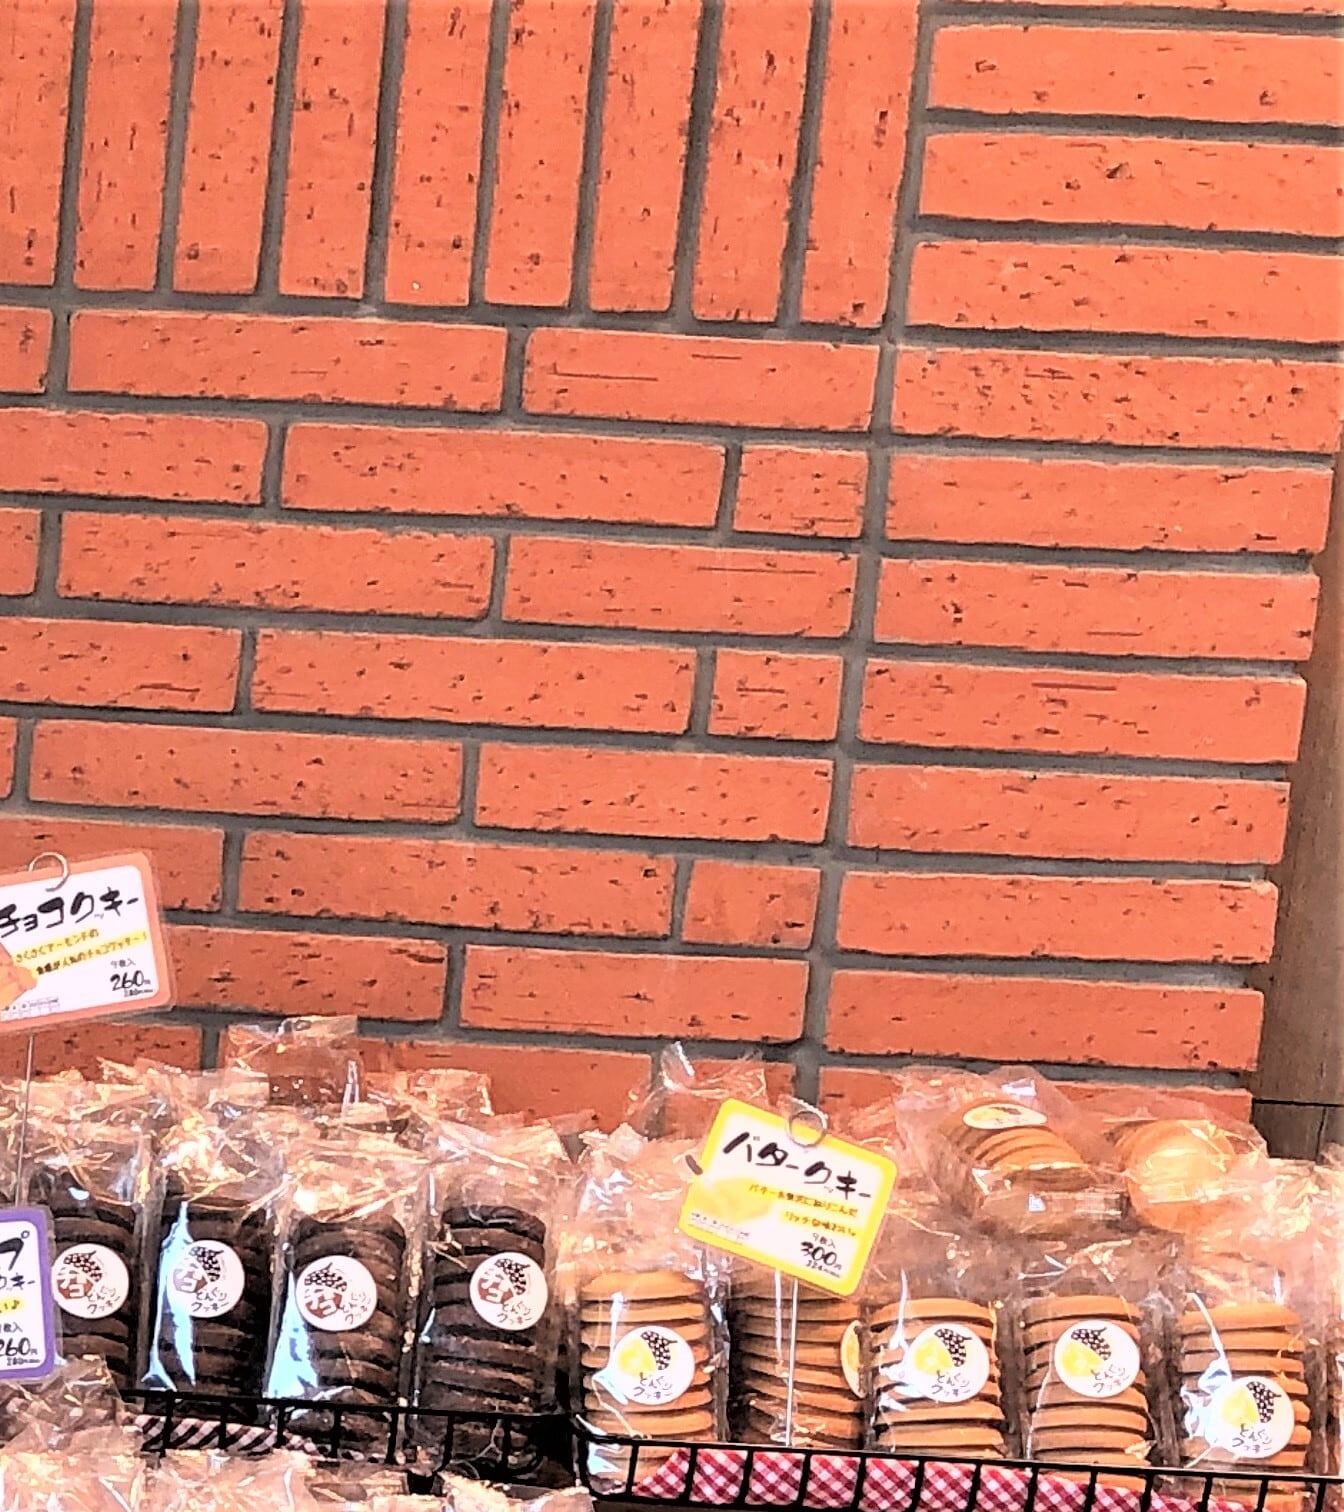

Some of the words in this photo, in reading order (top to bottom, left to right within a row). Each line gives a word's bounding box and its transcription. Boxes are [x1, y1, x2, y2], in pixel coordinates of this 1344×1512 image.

[723, 1132, 871, 1200] バタークッキー
